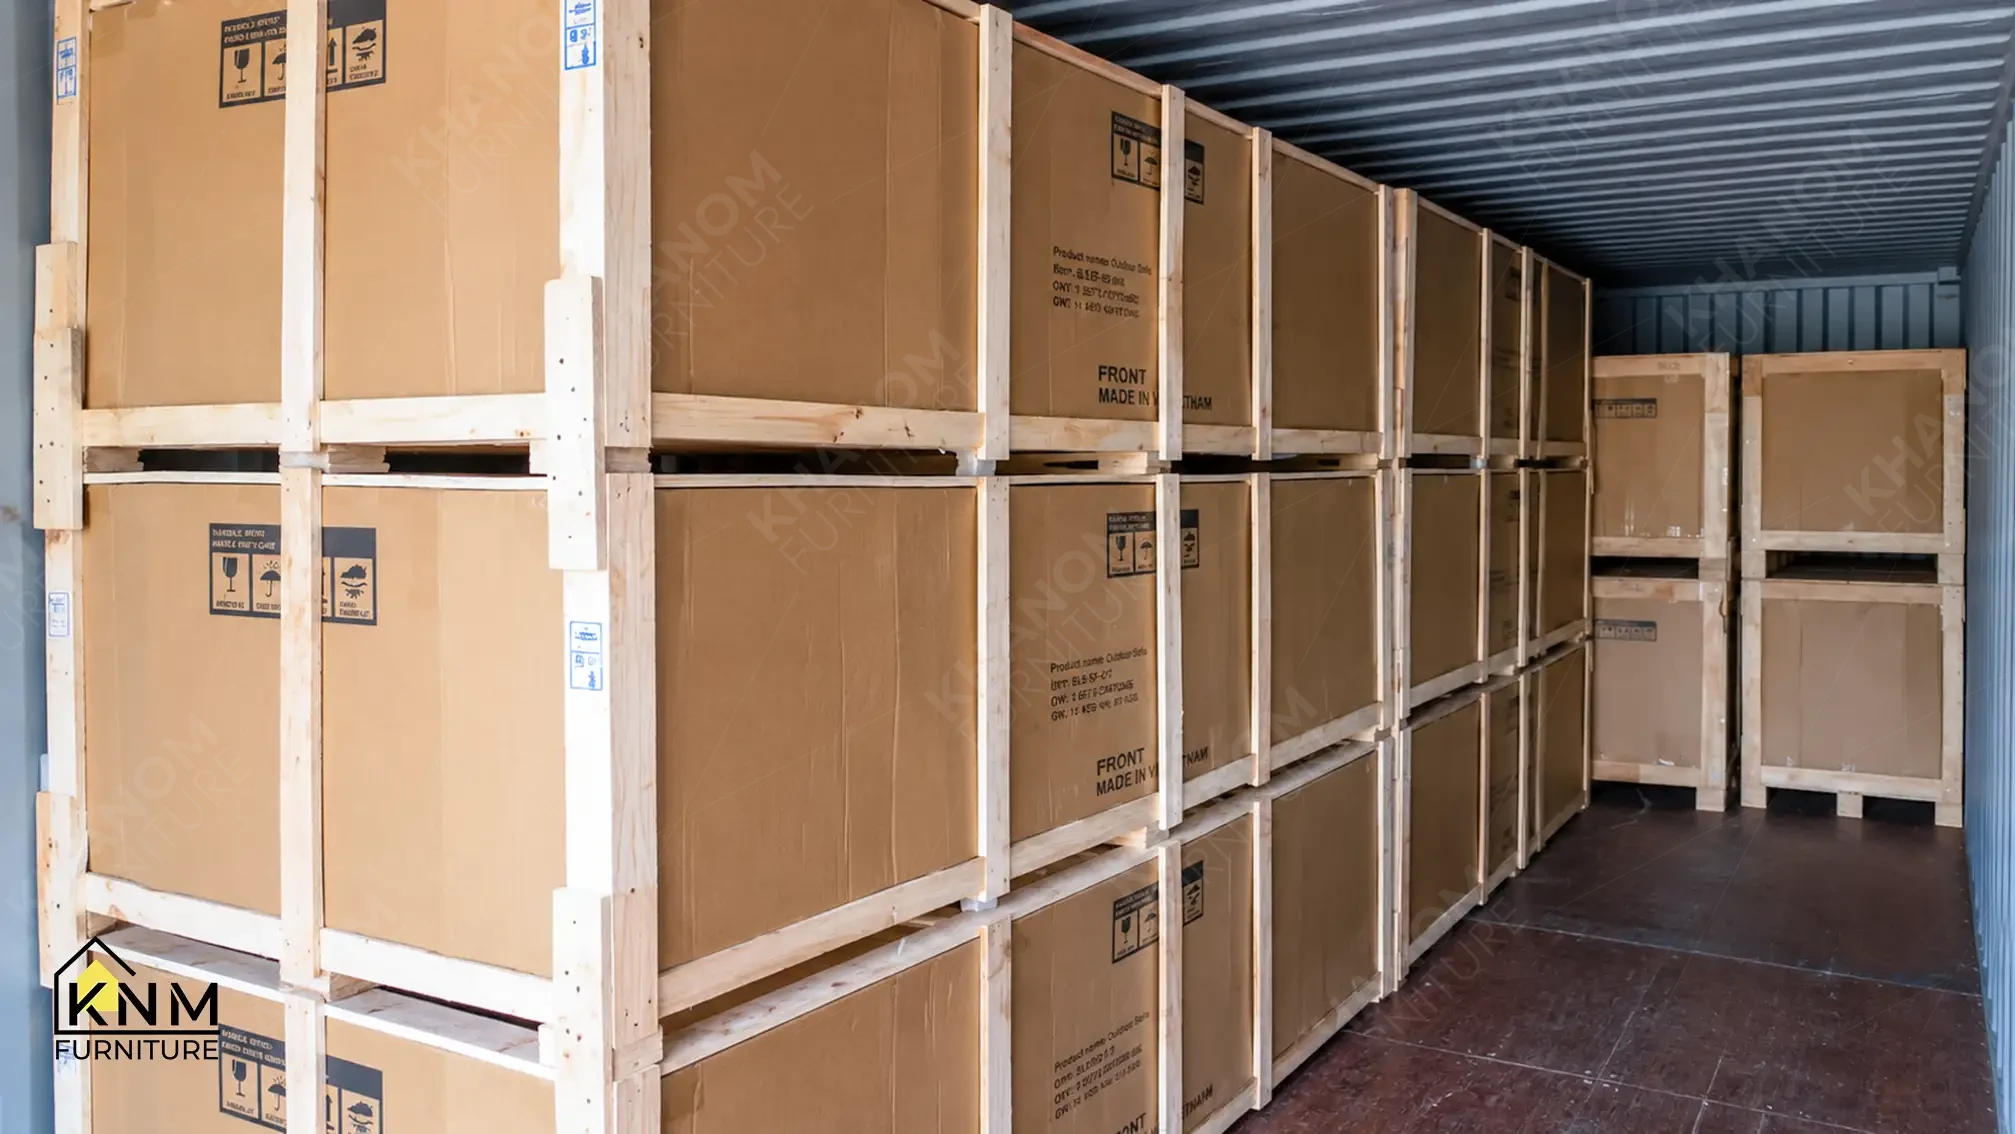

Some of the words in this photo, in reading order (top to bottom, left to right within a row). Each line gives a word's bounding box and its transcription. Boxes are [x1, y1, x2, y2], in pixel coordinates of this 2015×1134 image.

[1098, 365, 1147, 385] FRONT
[1098, 388, 1135, 405] MADE
[1138, 391, 1150, 406] IN
[1097, 748, 1144, 776] FRONT
[1096, 771, 1132, 796] MADE
[1135, 768, 1146, 784] IN
